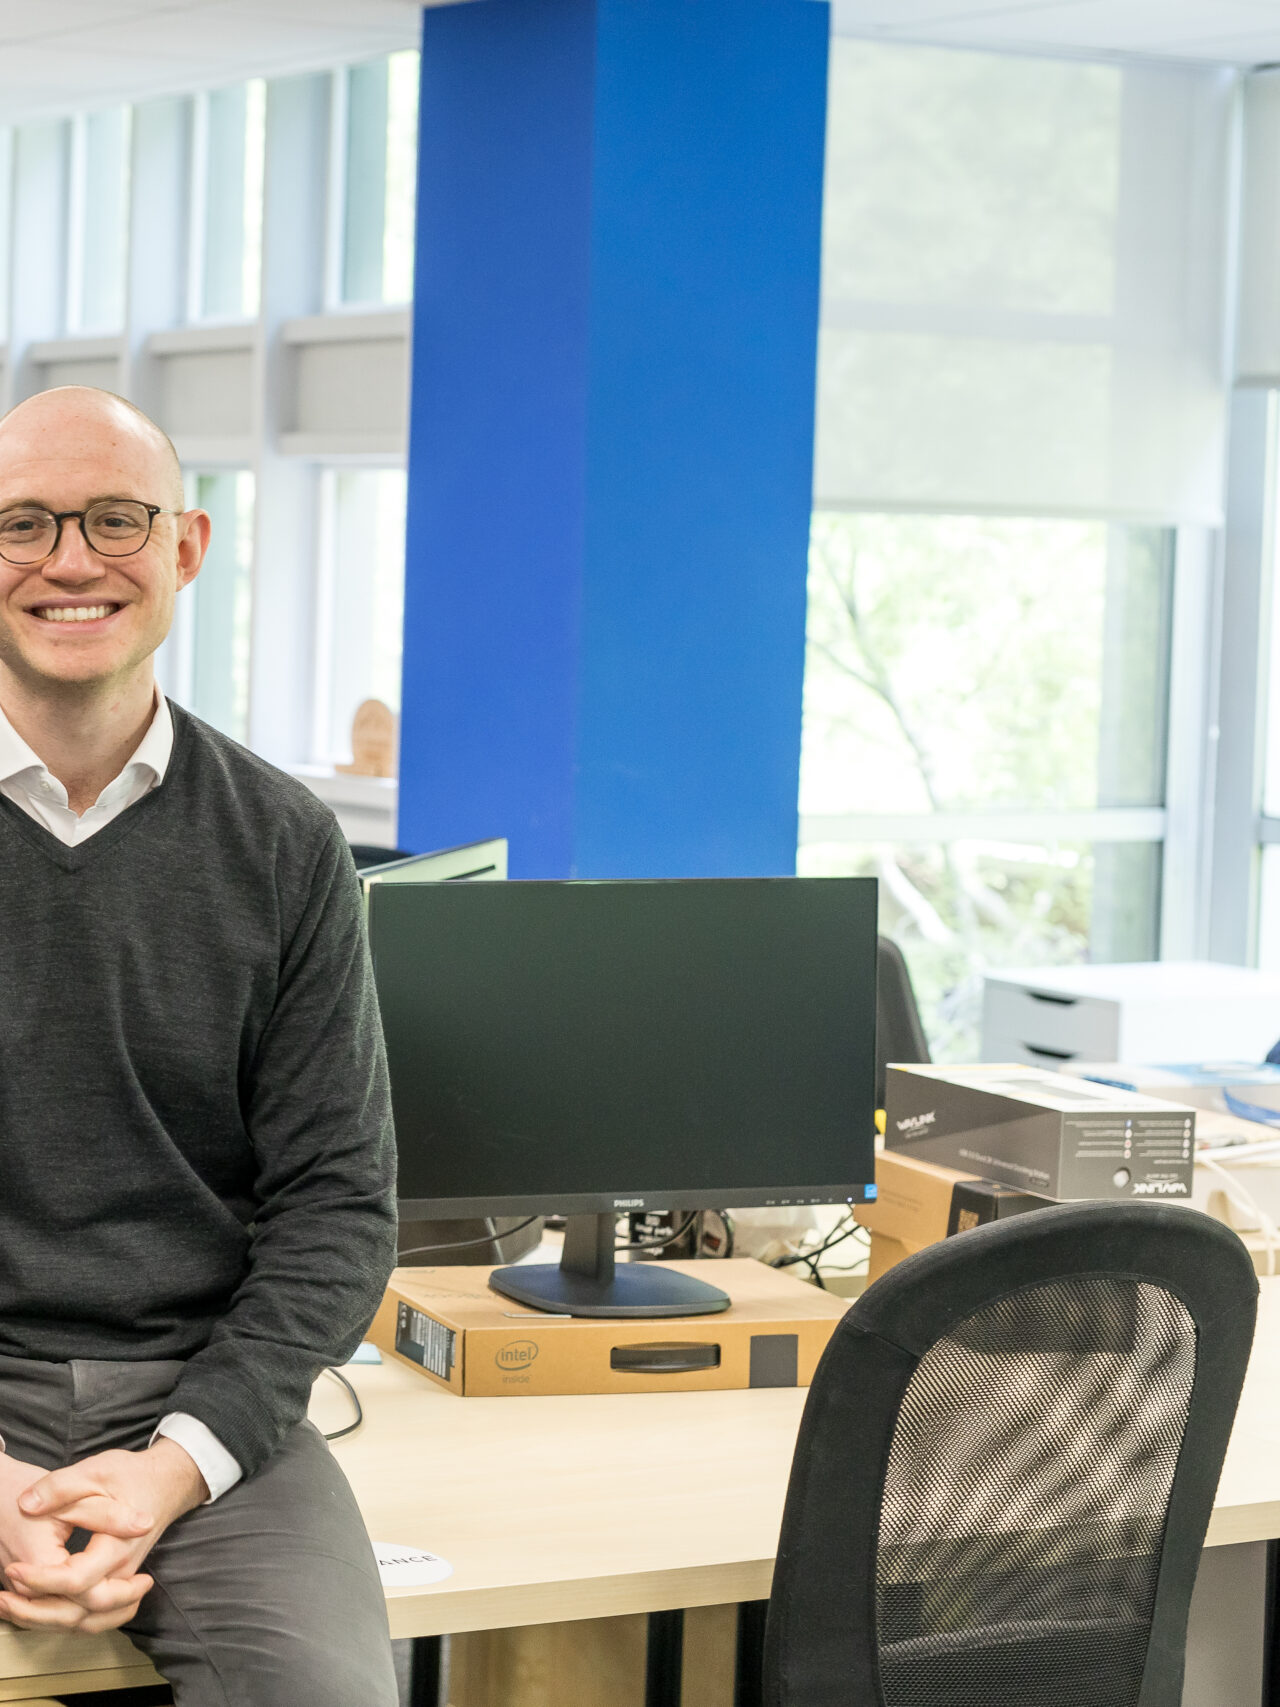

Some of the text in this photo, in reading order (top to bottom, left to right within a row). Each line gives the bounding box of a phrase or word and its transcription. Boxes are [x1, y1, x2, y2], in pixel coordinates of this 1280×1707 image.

[1131, 1183, 1187, 1195] WAVLINK
[614, 1199, 644, 1207] PHILIPS
[501, 1347, 532, 1362] intel
[502, 1375, 530, 1384] inside
